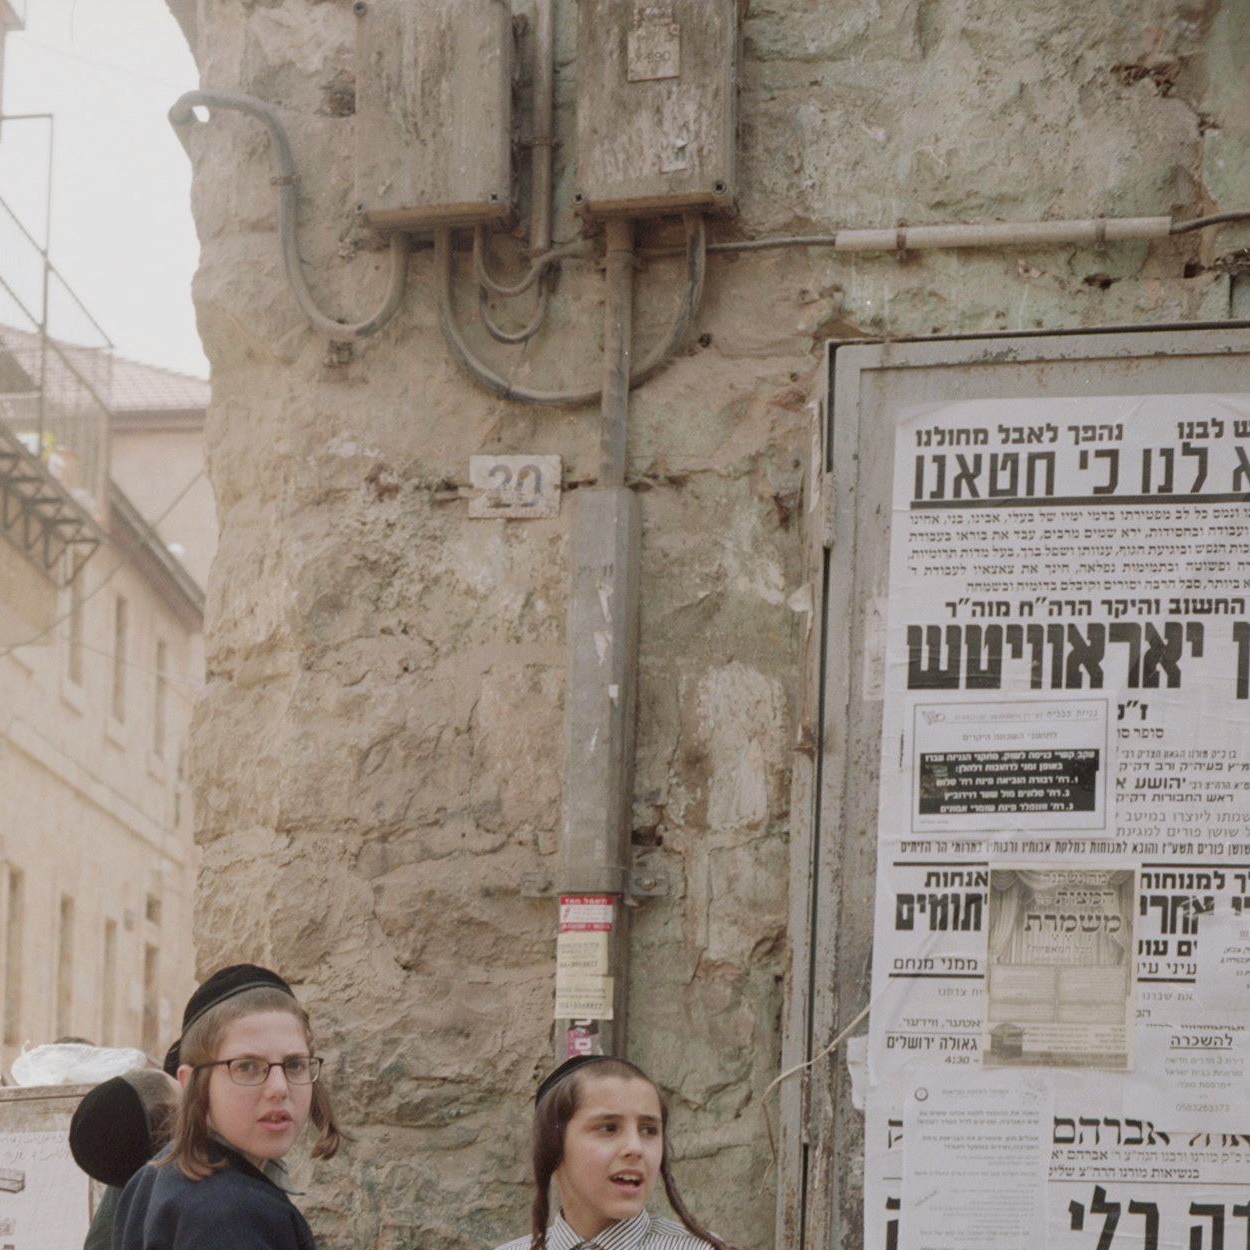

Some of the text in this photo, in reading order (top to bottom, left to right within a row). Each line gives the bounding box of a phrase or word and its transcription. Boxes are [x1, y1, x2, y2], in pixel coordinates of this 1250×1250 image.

[916, 426, 989, 447] מחולנו
[998, 423, 1059, 445] לאבל
[1067, 423, 1124, 446] נהפך
[1177, 418, 1224, 440] לבנו
[914, 451, 1056, 500] חטאנו
[1079, 449, 1119, 495] כי
[1141, 442, 1209, 494] לנו
[488, 464, 542, 508] 20
[945, 597, 1245, 618] החשוב והיקר הרה"ח מוה"ר
[907, 621, 1205, 690] יאראוויטש
[1134, 728, 1164, 739] סופר
[1134, 777, 1186, 790] יהושע
[1167, 827, 1202, 837] פורים
[1208, 827, 1239, 838] שושן
[893, 957, 934, 970] מנחם
[942, 958, 978, 971] ממני
[1167, 962, 1197, 975] עיני
[887, 1035, 978, 1051] גאולה ירושלים
[1170, 1033, 1233, 1046] להשכרה
[945, 1055, 969, 1065] 4:30
